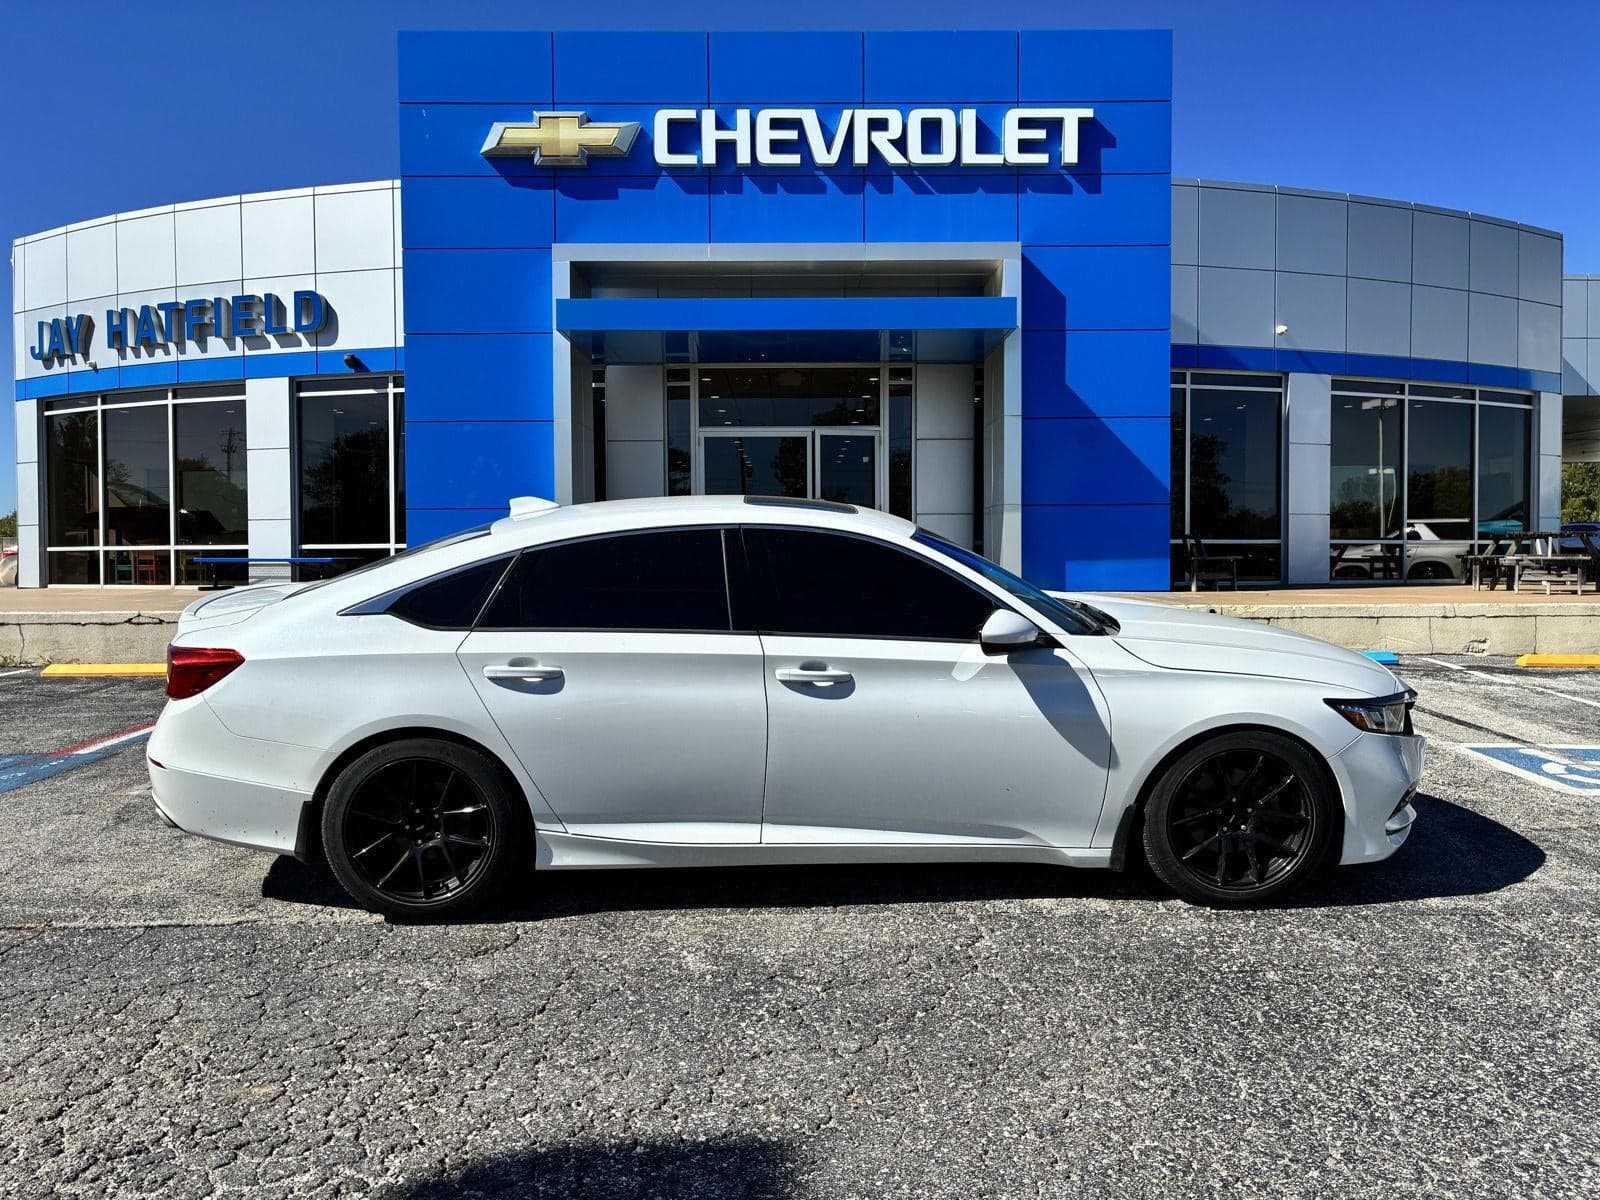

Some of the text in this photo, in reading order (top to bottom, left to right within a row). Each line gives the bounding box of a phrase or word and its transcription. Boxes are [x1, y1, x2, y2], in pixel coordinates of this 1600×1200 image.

[653, 108, 1095, 168] CHEVROLET
[30, 290, 327, 361] JAY HATFIELD
